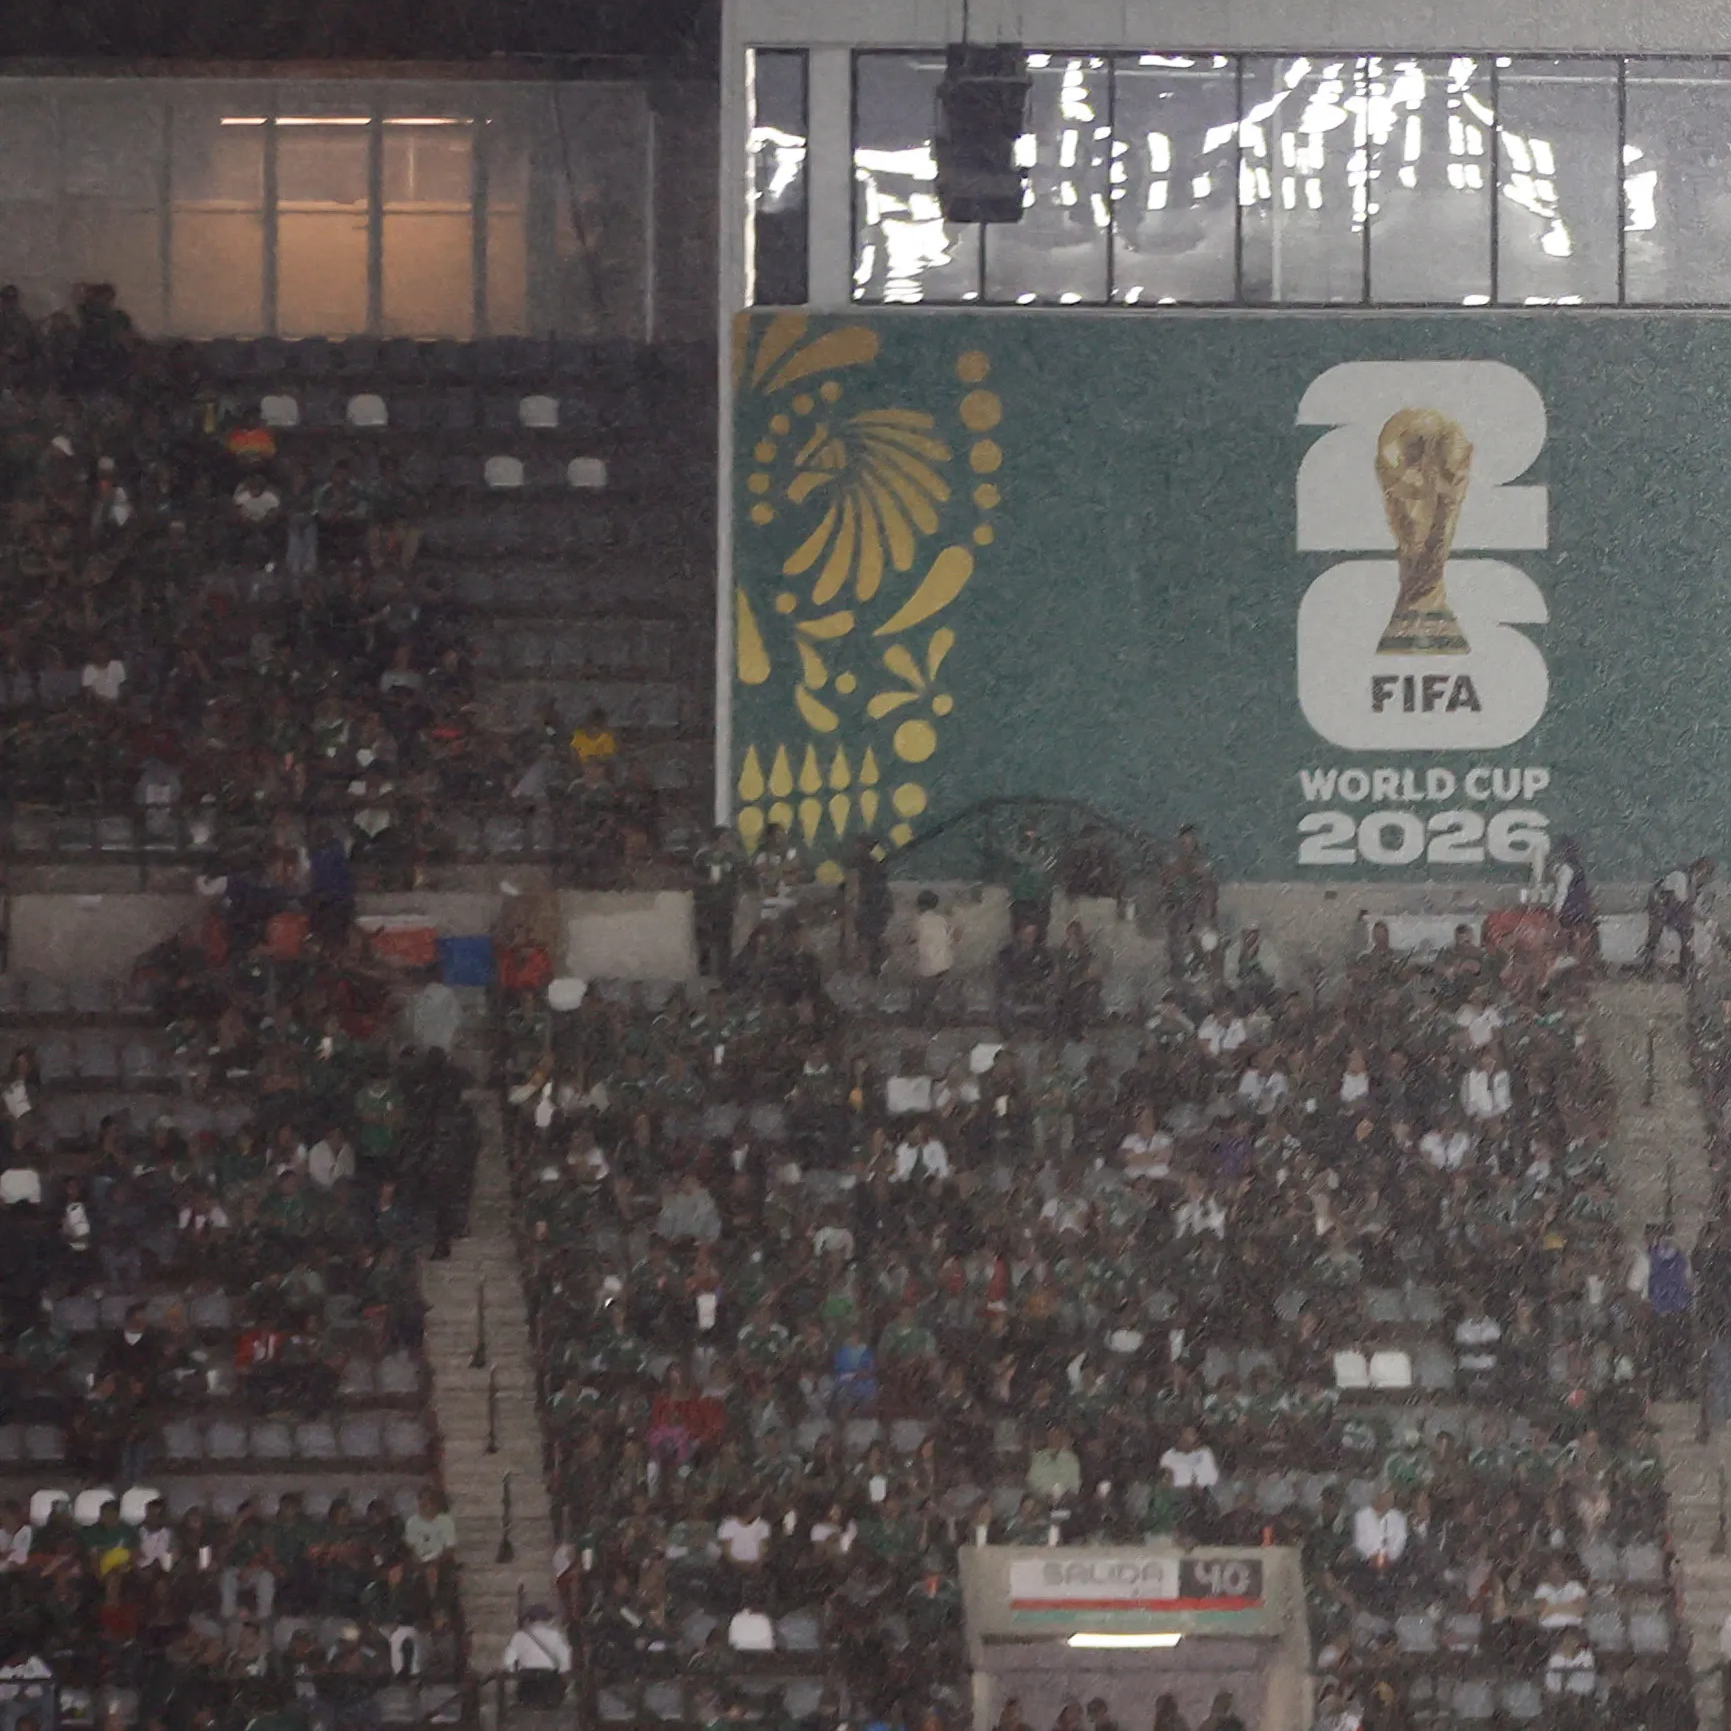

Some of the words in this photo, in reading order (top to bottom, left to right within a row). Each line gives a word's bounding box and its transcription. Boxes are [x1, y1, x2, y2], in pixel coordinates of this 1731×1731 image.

[1371, 674, 1482, 713] FIFA
[1301, 768, 1456, 802] WORLD
[1464, 767, 1551, 802] CUP
[1297, 810, 1551, 865] 2026
[1042, 1560, 1164, 1587] SALIDA
[1194, 1560, 1250, 1596] 40
